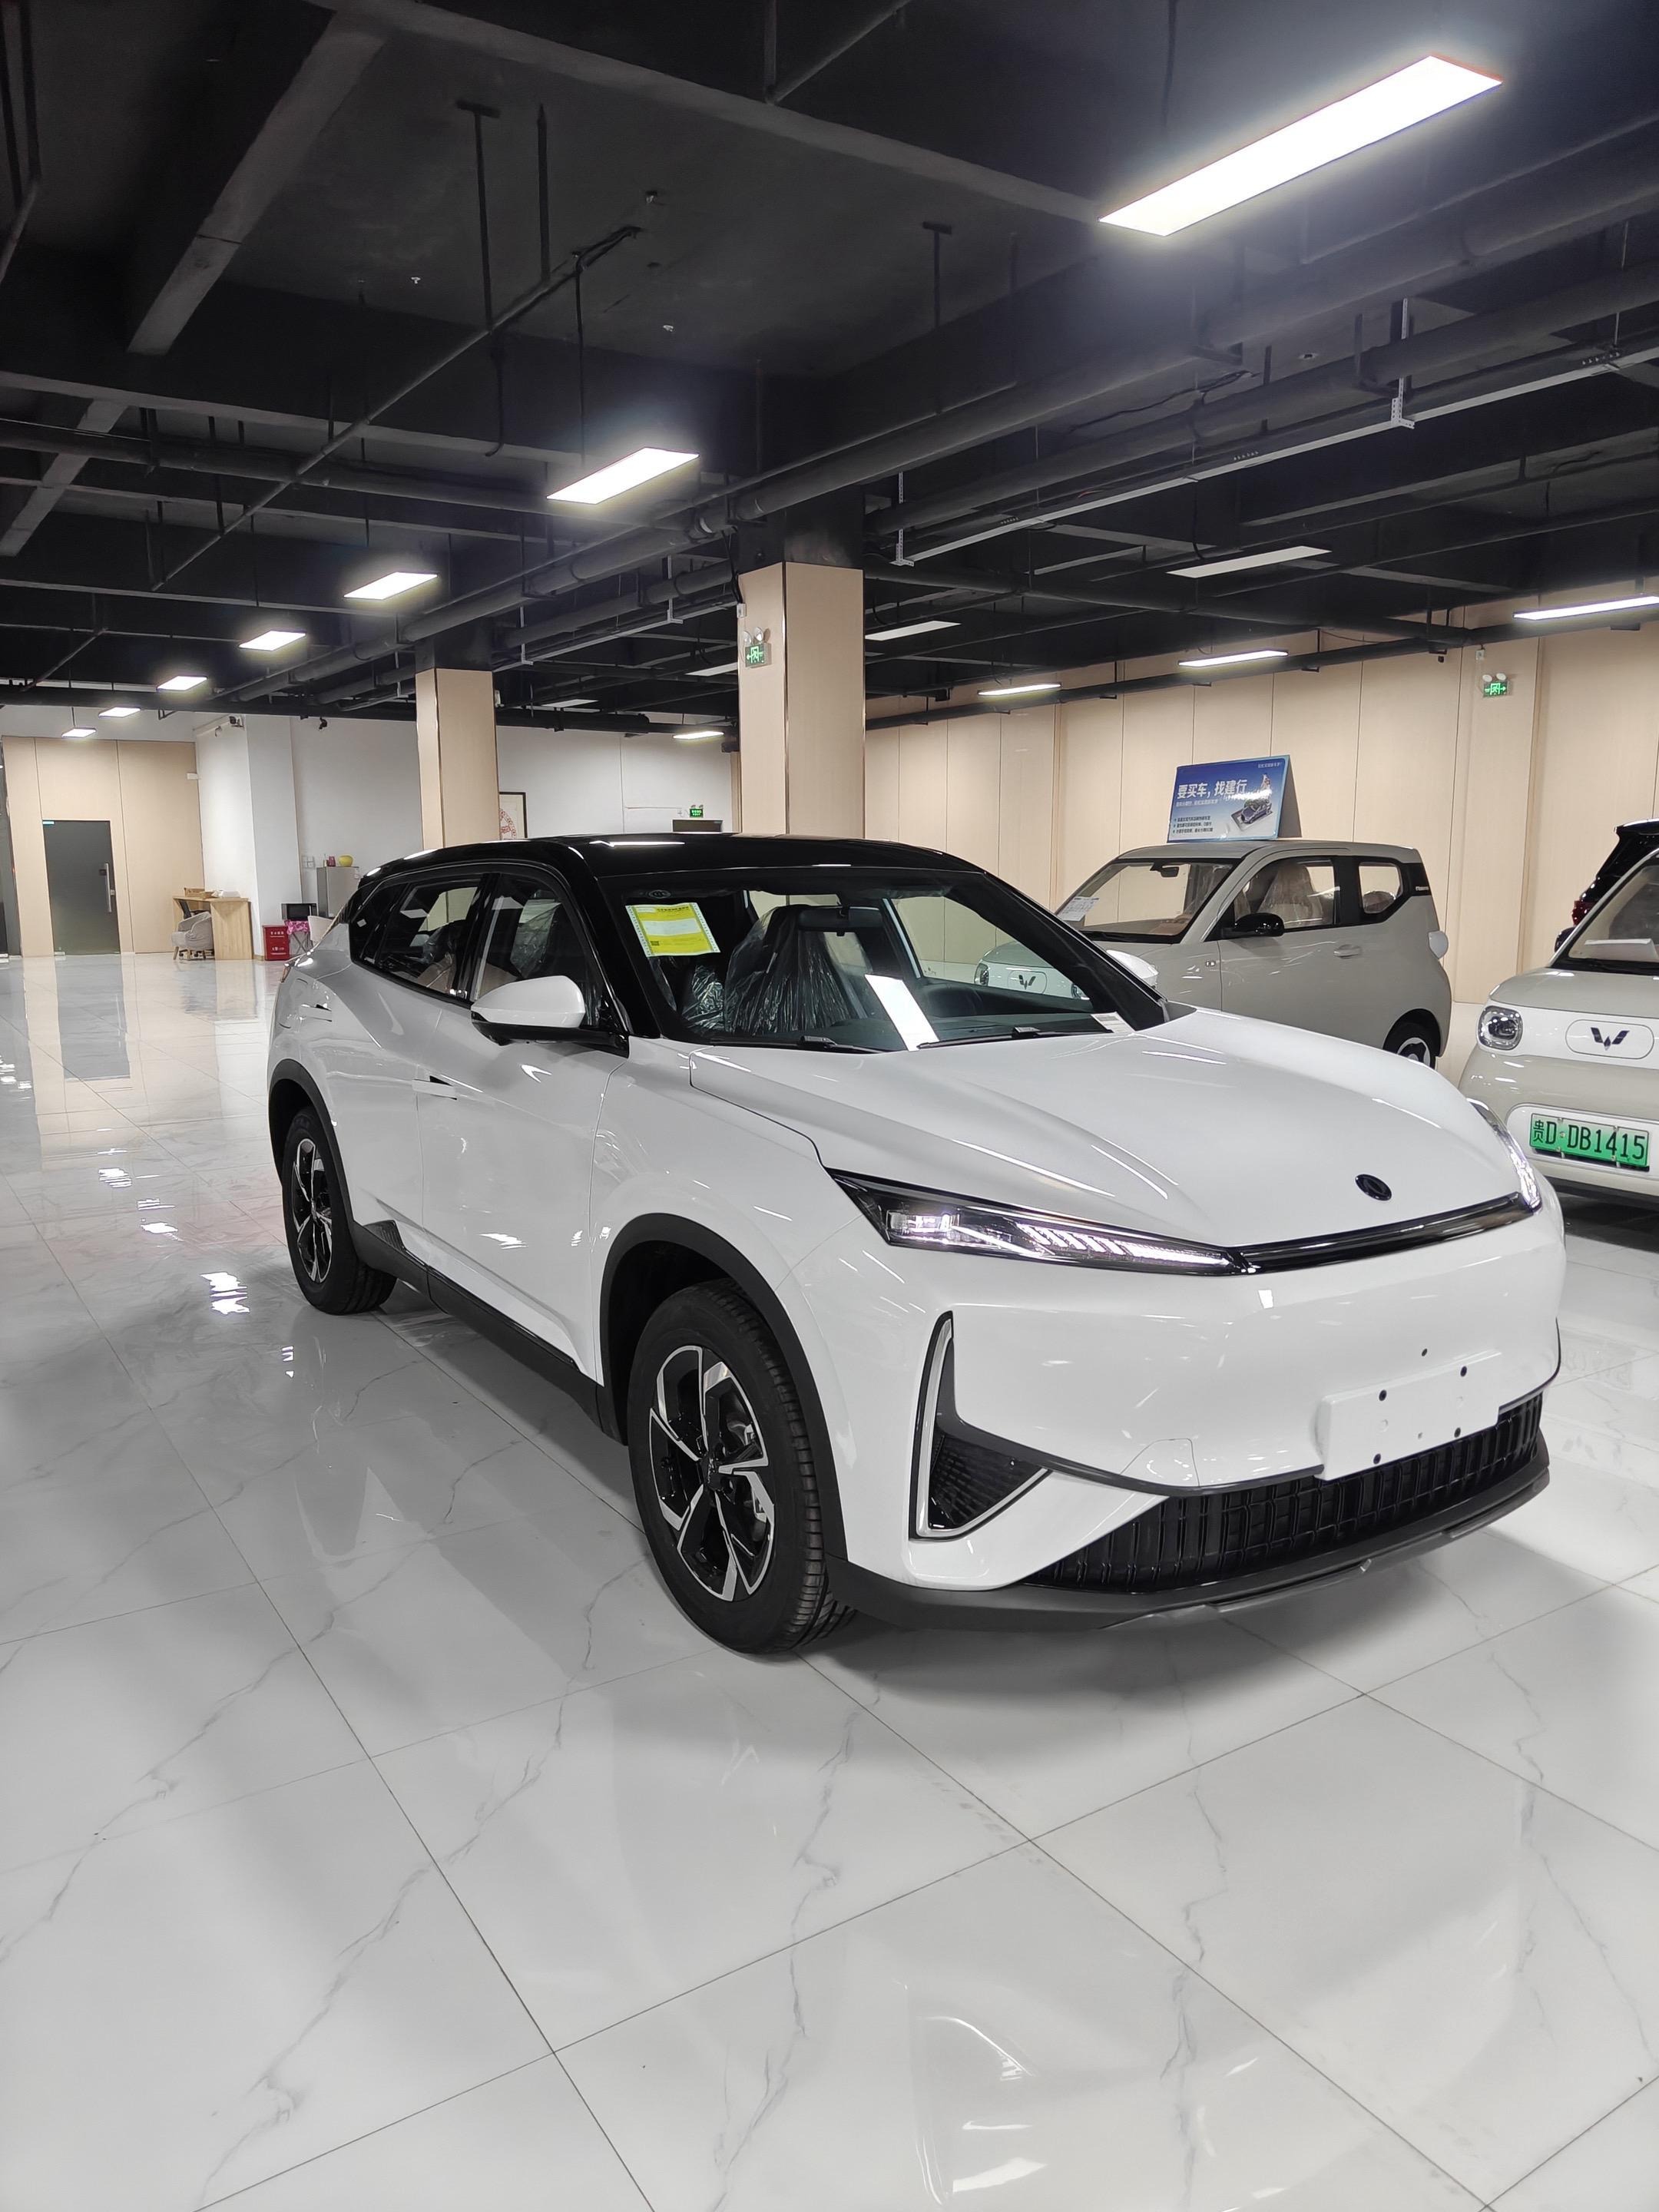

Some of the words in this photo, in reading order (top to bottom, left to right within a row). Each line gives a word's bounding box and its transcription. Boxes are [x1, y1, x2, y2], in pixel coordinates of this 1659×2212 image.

[1177, 780, 1248, 799] 要买车，找建行
